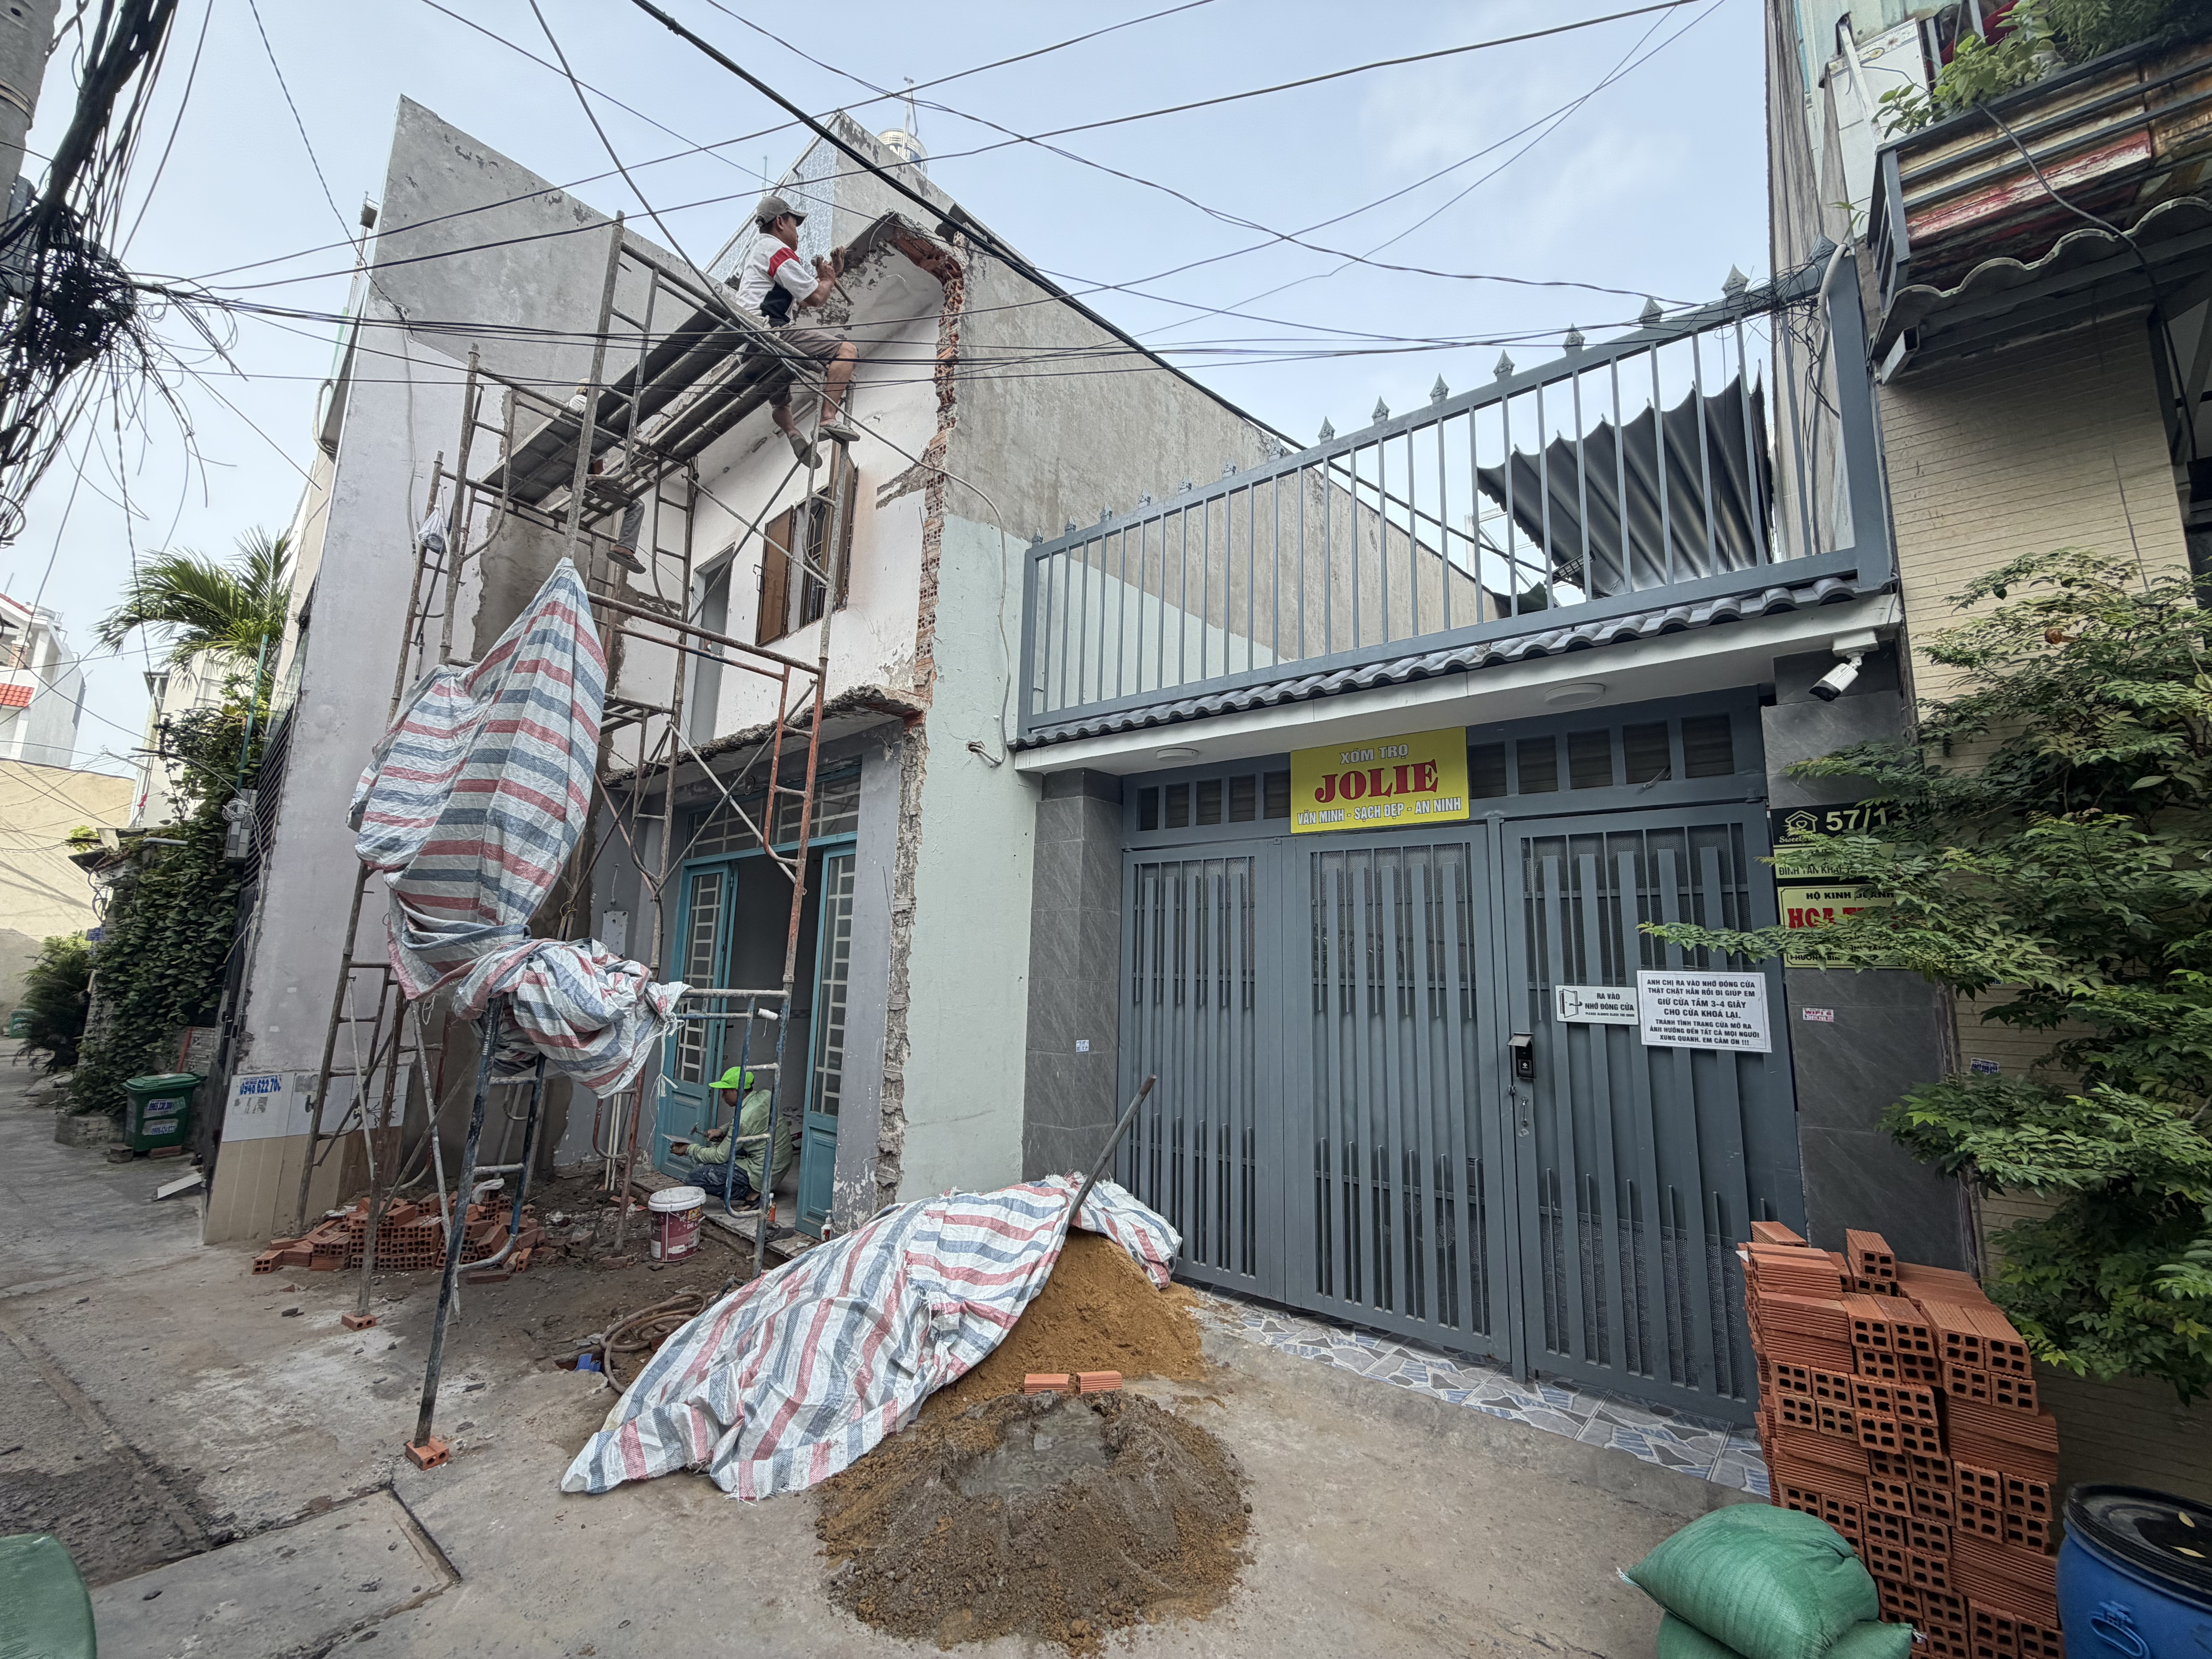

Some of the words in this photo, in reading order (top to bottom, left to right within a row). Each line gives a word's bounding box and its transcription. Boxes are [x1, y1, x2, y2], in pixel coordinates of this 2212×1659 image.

[1340, 748, 1374, 764] XÓM
[1379, 744, 1408, 759] TRỌ
[1315, 759, 1438, 803] JOLIE
[1297, 809, 1316, 825] VĂN
[1319, 809, 1344, 823] MINH
[1354, 805, 1381, 822] SẠCH
[1384, 803, 1404, 819] ĐẸP
[1414, 799, 1430, 814] AN
[1433, 797, 1461, 812] NINH
[1806, 891, 1821, 900] HỘ
[1607, 992, 1620, 1000] VÀO
[1600, 1002, 1618, 1010] ĐÓNG
[1620, 1002, 1634, 1011] CỬA
[1657, 997, 1671, 1005] GIỮ
[1673, 997, 1689, 1006] CỬA
[1691, 997, 1709, 1007] TẦM
[1728, 1000, 1746, 1008] GIÂY
[1683, 1008, 1699, 1017] CỬA
[1701, 1009, 1723, 1018] KHOÁ
[1726, 1011, 1741, 1019] LẠI.
